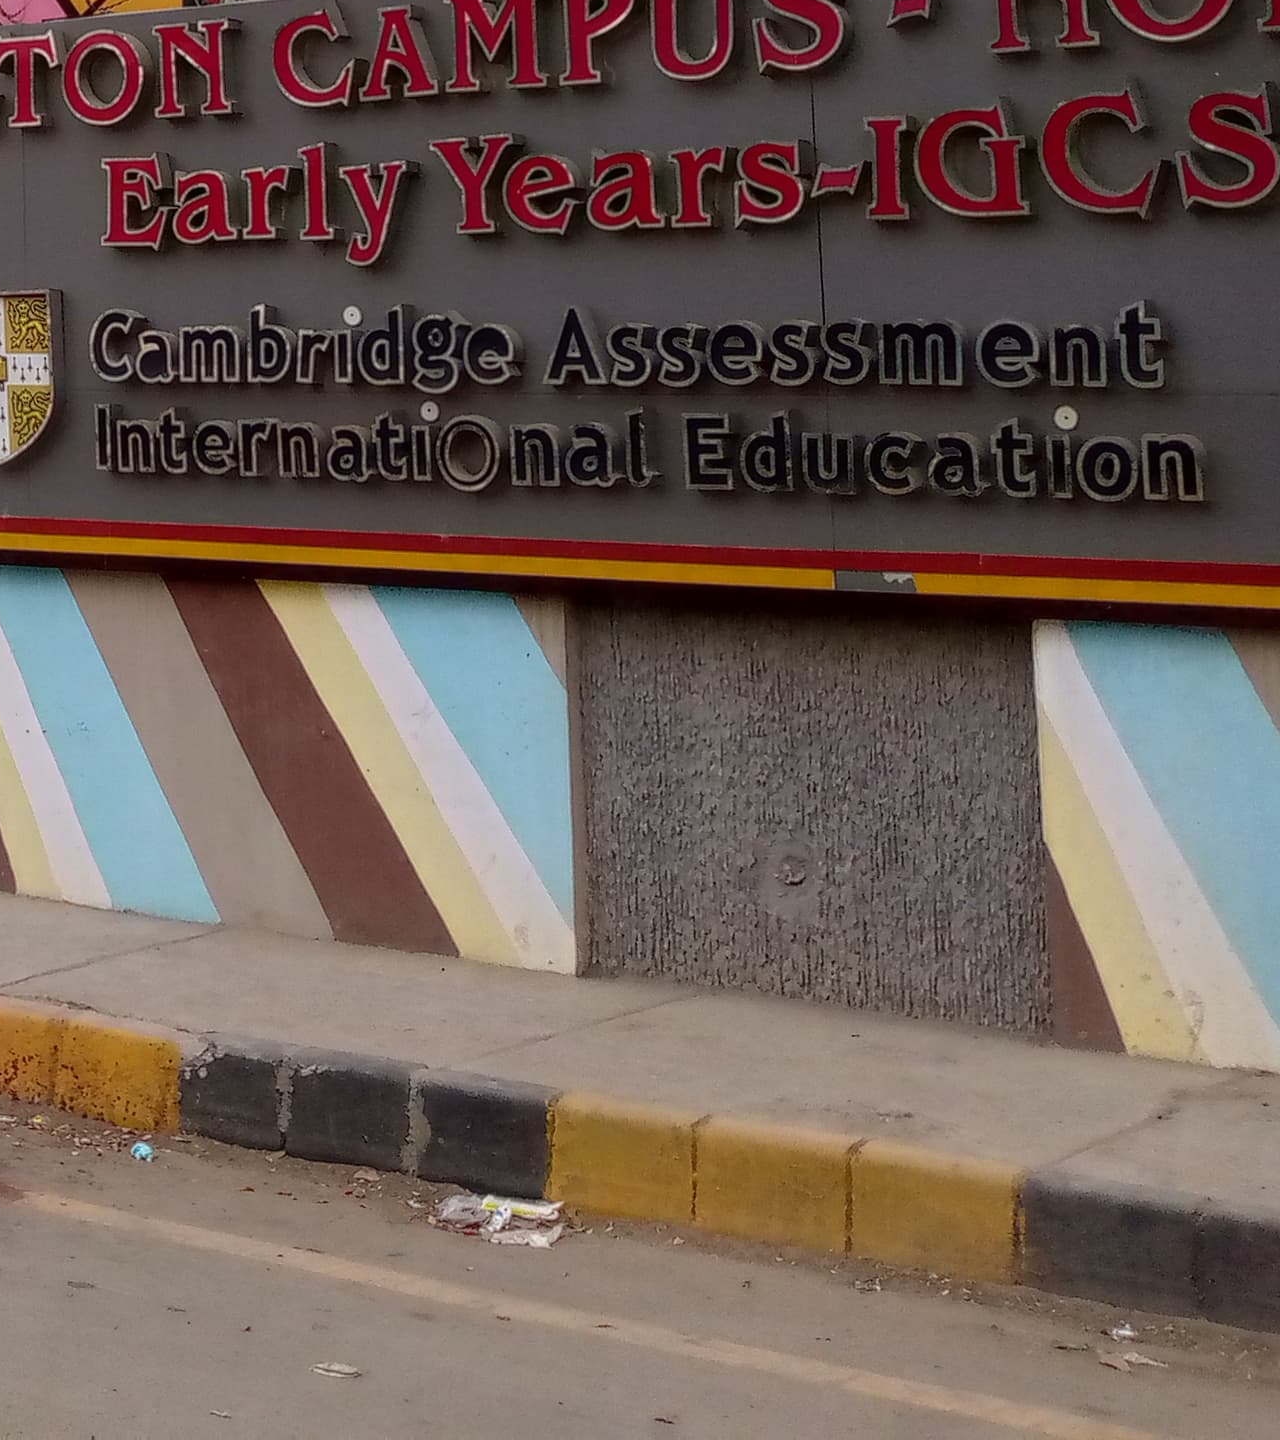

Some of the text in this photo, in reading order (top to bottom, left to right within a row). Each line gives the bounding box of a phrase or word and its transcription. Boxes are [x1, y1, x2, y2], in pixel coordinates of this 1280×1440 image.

[100, 142, 415, 267] Early
[89, 299, 1168, 394] Cambridge Assessment
[94, 400, 1207, 503] International Education
